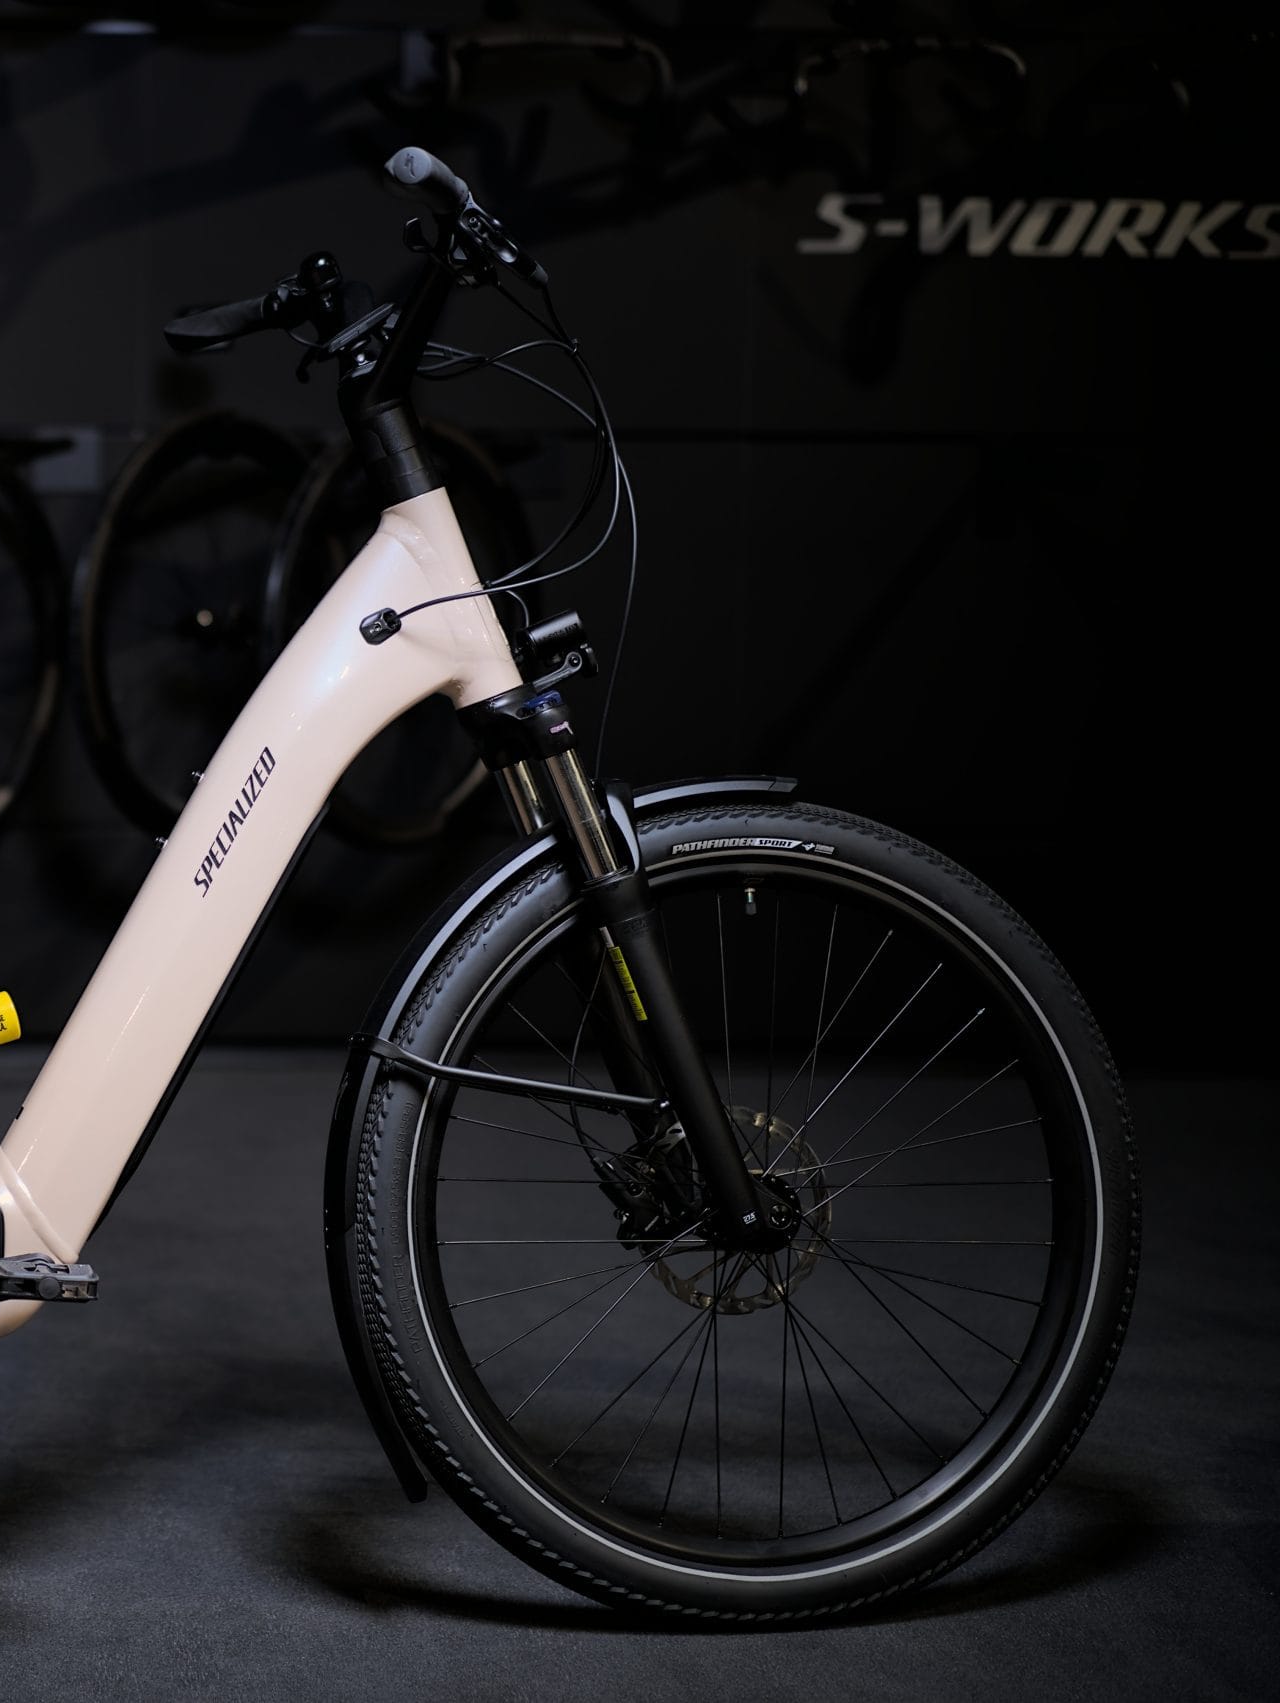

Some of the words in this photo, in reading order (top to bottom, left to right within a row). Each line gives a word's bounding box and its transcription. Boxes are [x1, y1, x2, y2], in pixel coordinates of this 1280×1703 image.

[796, 192, 1280, 260] S-WORKS
[193, 746, 276, 898] SPECIALIZED
[672, 838, 754, 855] PATHFINDER
[757, 838, 794, 848] SPORT
